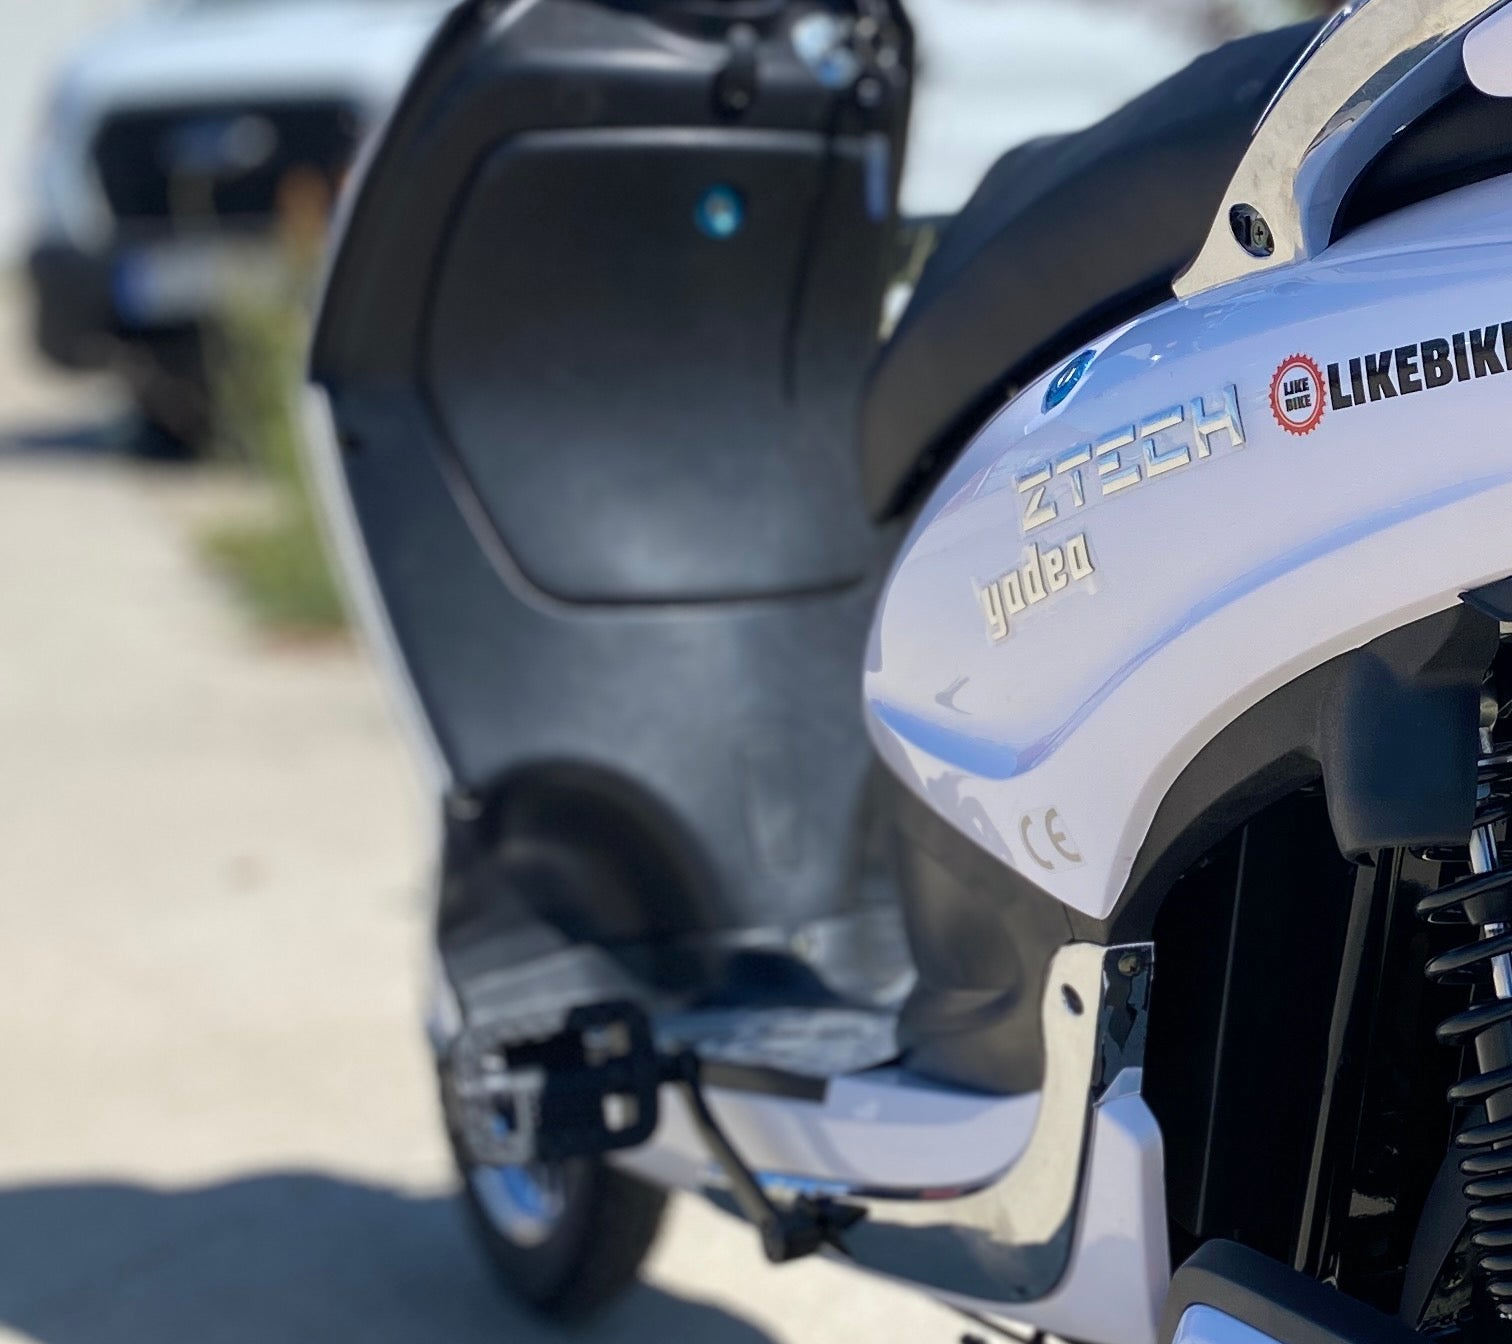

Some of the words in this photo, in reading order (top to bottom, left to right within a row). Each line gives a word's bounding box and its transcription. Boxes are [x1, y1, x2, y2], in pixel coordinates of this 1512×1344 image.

[1283, 376, 1310, 396] LIKE
[1285, 394, 1312, 412] BIKE
[1014, 383, 1247, 532] ZTECH
[980, 532, 1096, 641] yadea
[1020, 807, 1082, 870] CE
